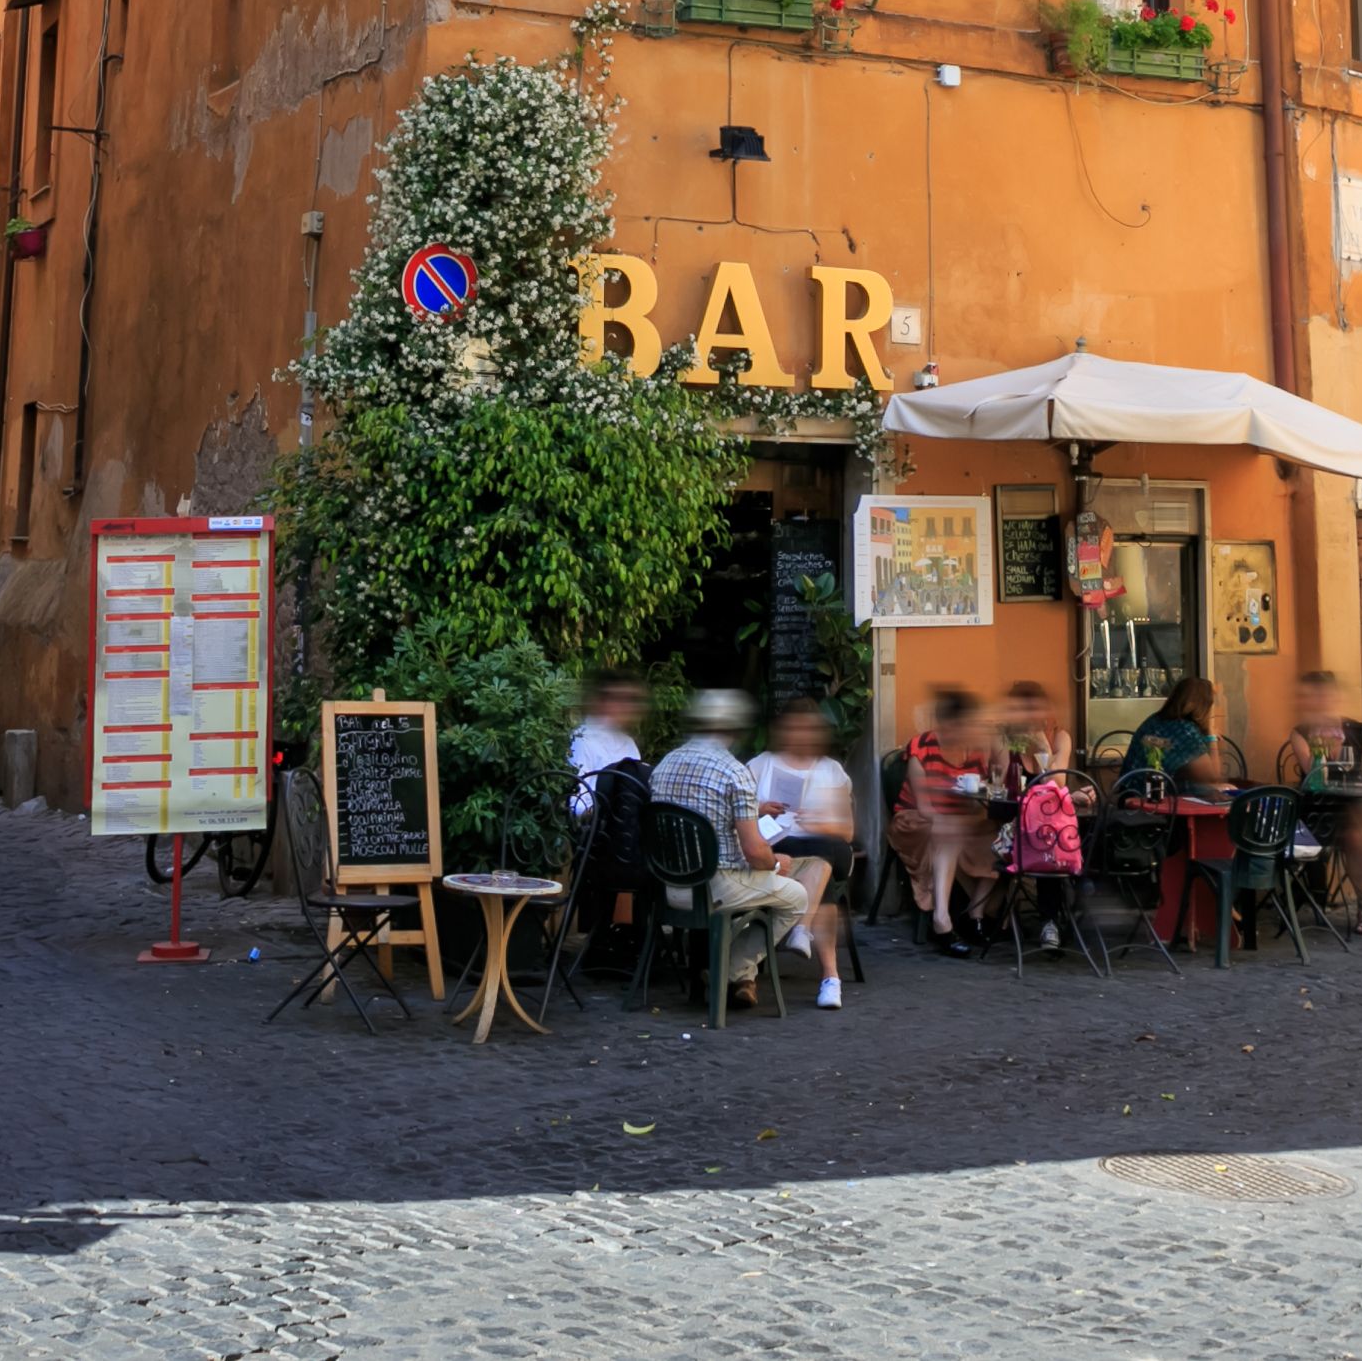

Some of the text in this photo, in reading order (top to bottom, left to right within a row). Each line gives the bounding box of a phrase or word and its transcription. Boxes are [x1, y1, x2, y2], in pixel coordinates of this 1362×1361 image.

[567, 252, 894, 391] BAR
[900, 314, 913, 337] 5
[1017, 539, 1037, 551] HAM
